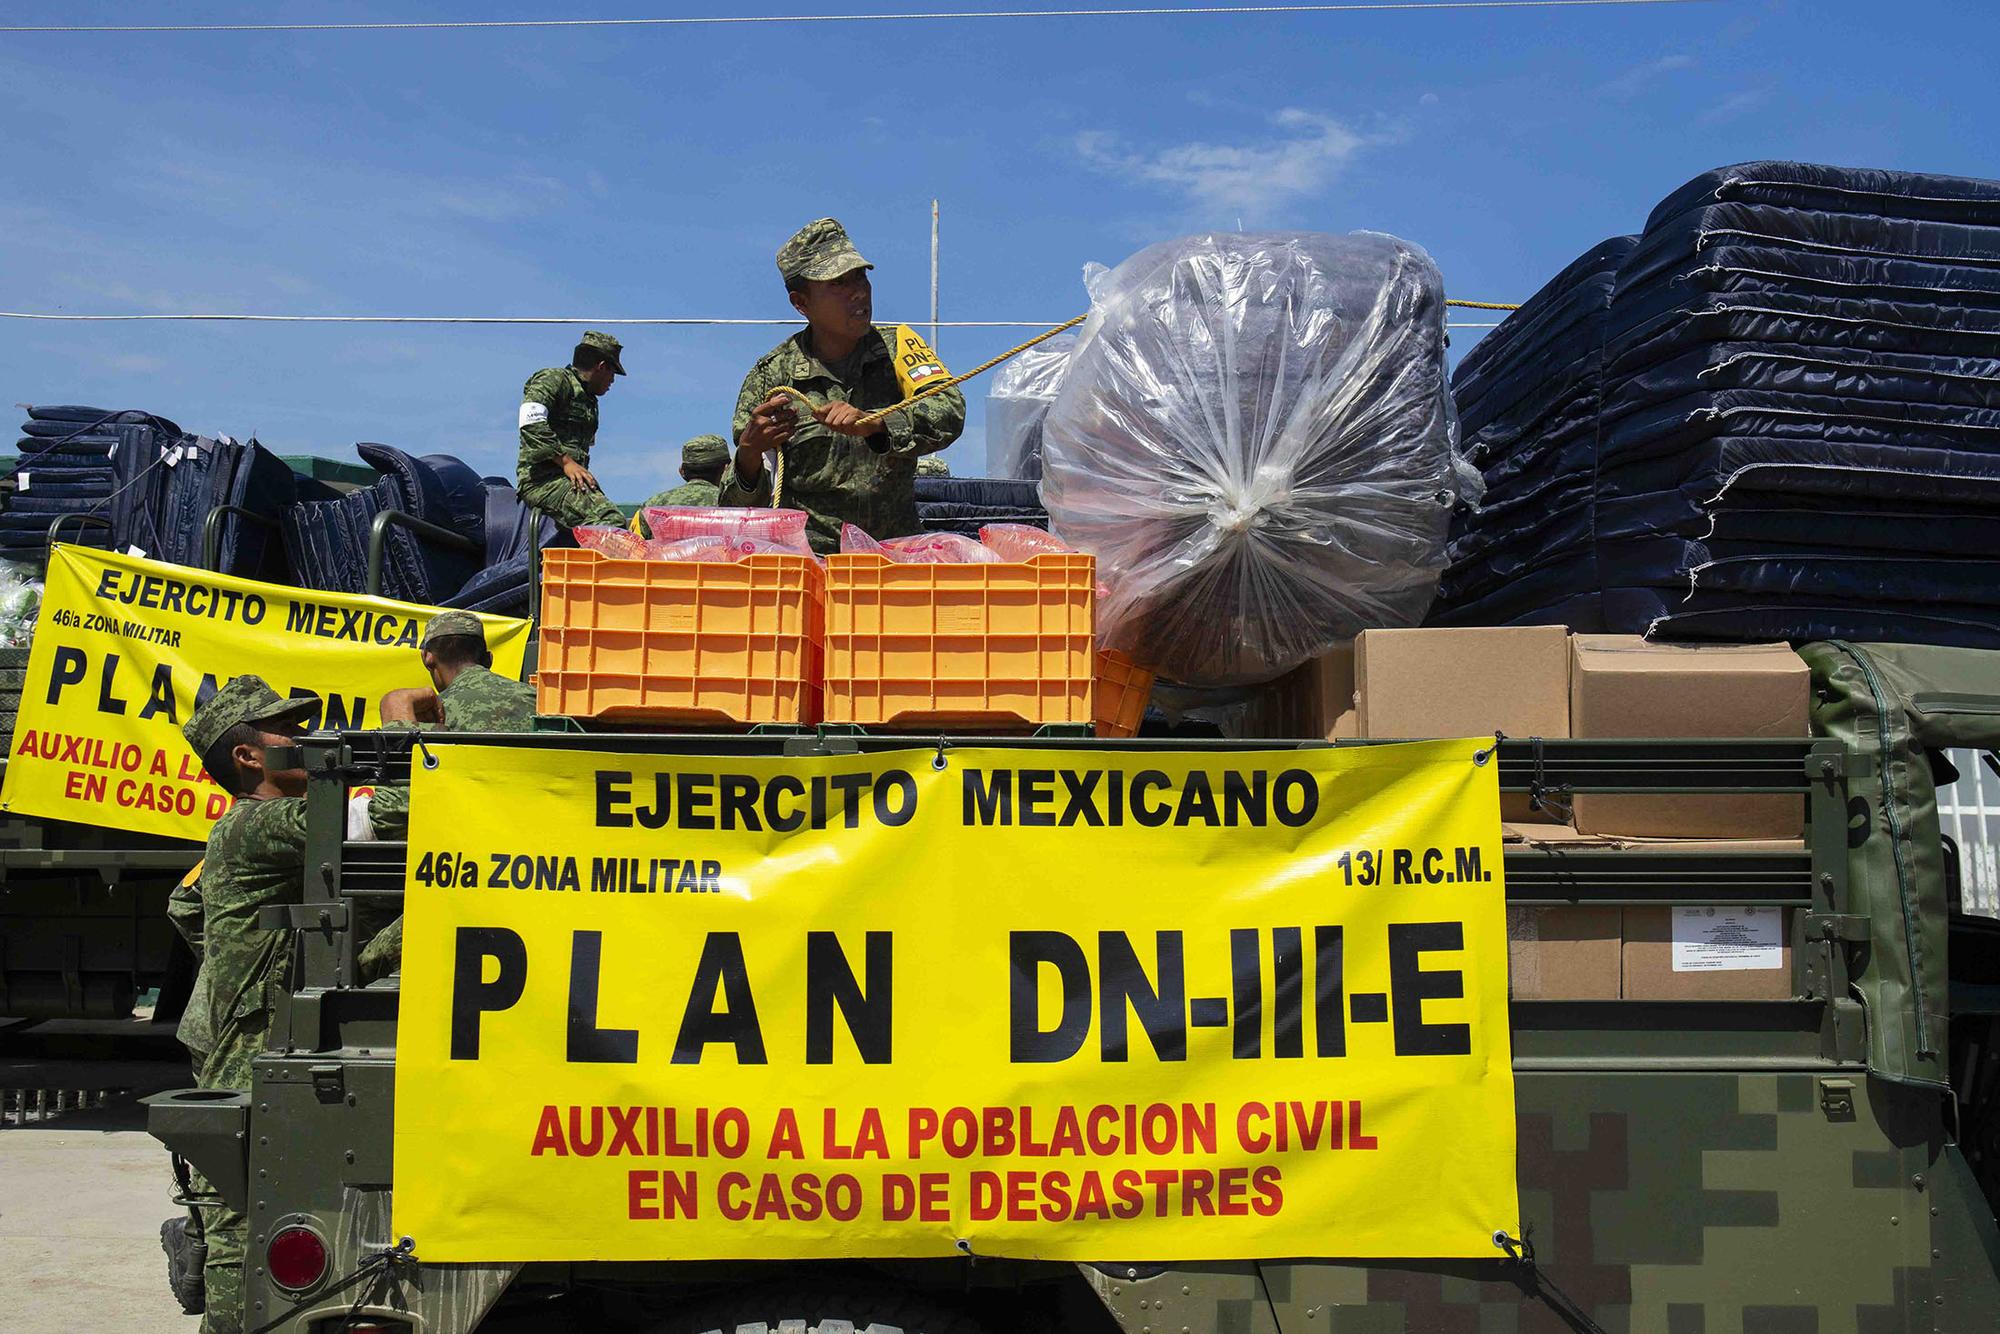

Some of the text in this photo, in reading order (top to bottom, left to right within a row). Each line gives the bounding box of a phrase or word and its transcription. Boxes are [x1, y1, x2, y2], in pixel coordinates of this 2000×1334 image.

[905, 338, 929, 351] PL
[53, 609, 181, 648] 46/a ZONA MILITAR
[96, 569, 427, 649] EJERCITO MEXICA
[17, 730, 141, 775] AUXILIO
[150, 750, 167, 777] A
[65, 772, 238, 820] EN CASO D
[595, 769, 1319, 832] EJERCITO MEXICANO
[416, 852, 721, 893] 46/a ZONA MILITAR
[1338, 847, 1491, 885] 13/ R.C.M.
[451, 922, 1471, 1064] PLAN DN-III-E
[531, 1101, 1377, 1159] AUXILIO A LA POBLACION CIVIL
[629, 1166, 1283, 1222] EN CASO DE DESASTRES
